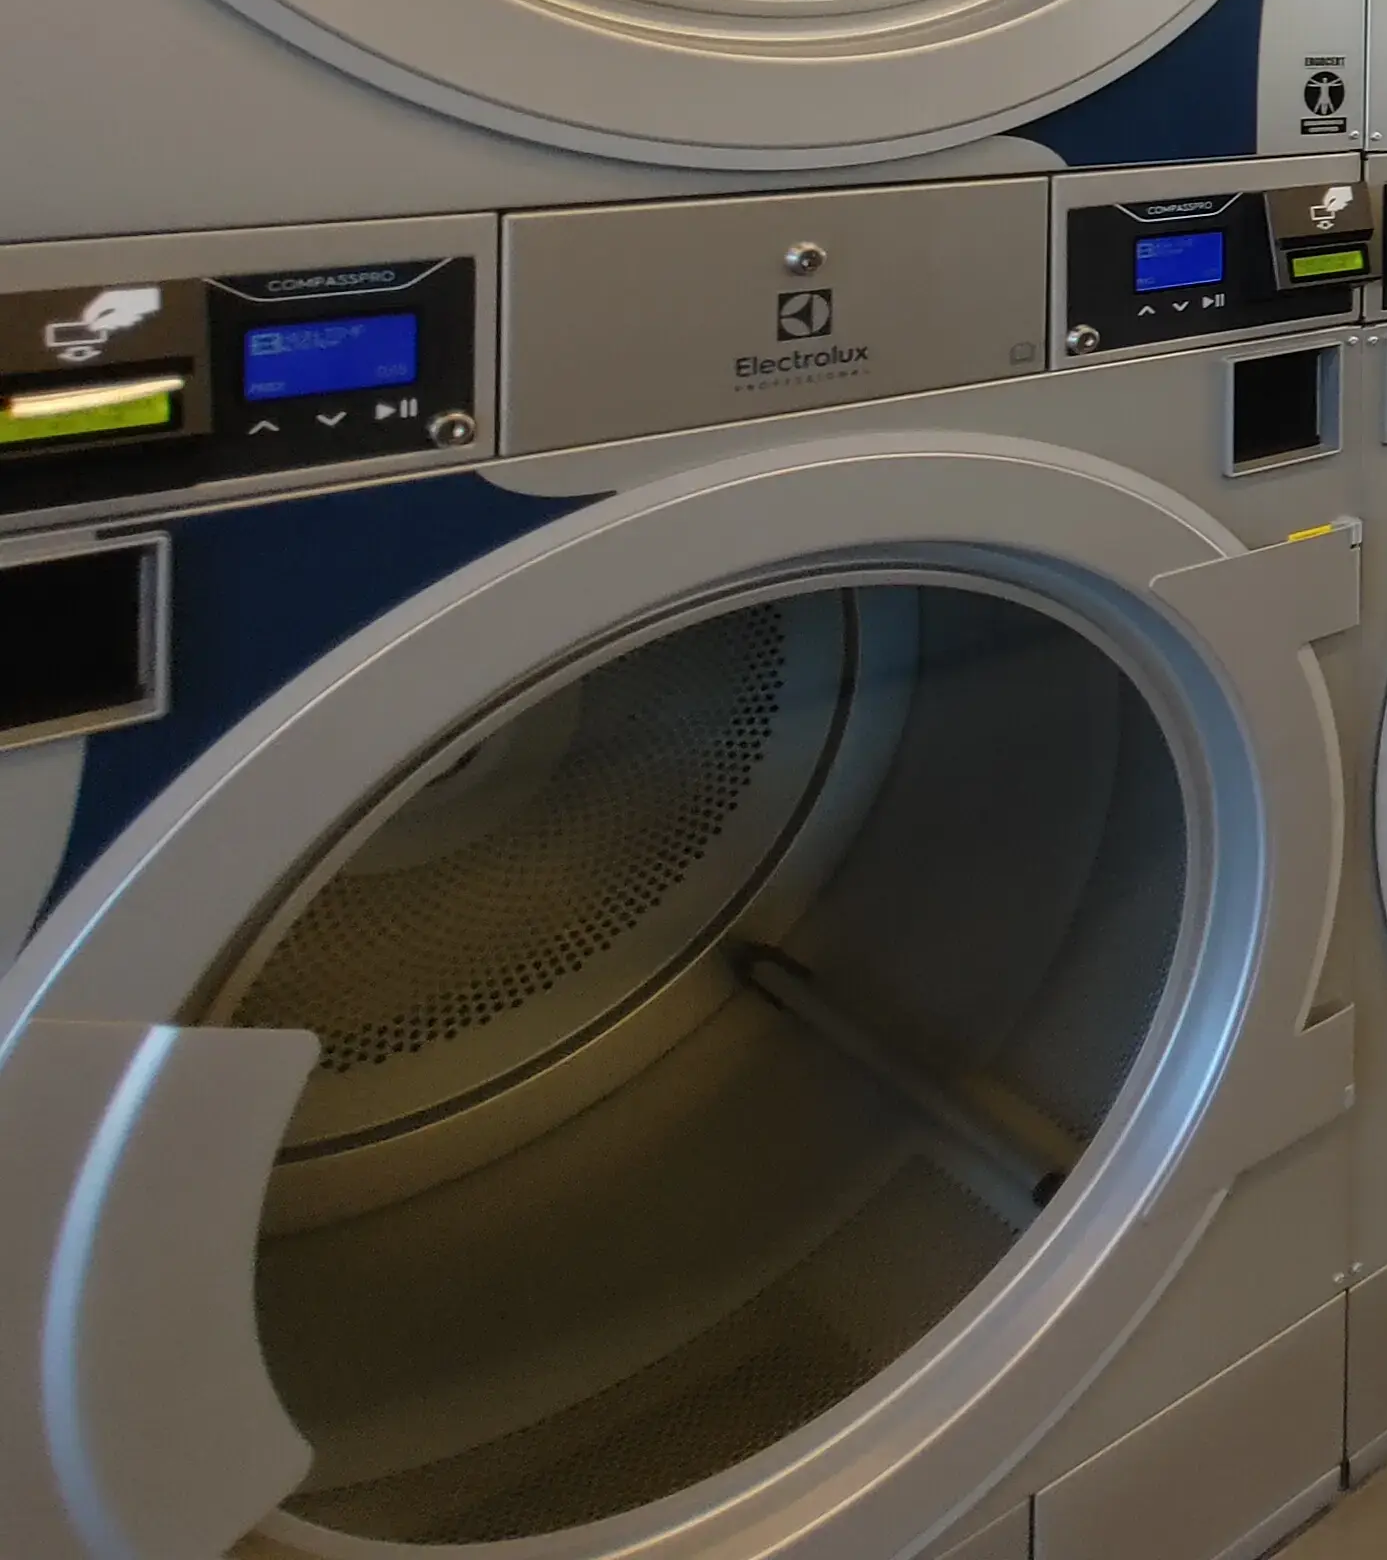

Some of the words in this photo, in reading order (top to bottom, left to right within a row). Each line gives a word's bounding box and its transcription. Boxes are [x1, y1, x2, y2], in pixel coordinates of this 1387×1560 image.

[1146, 200, 1213, 216] COMPASSPRO
[267, 270, 395, 292] COMPASSPRO
[735, 345, 868, 378] Electrolux
